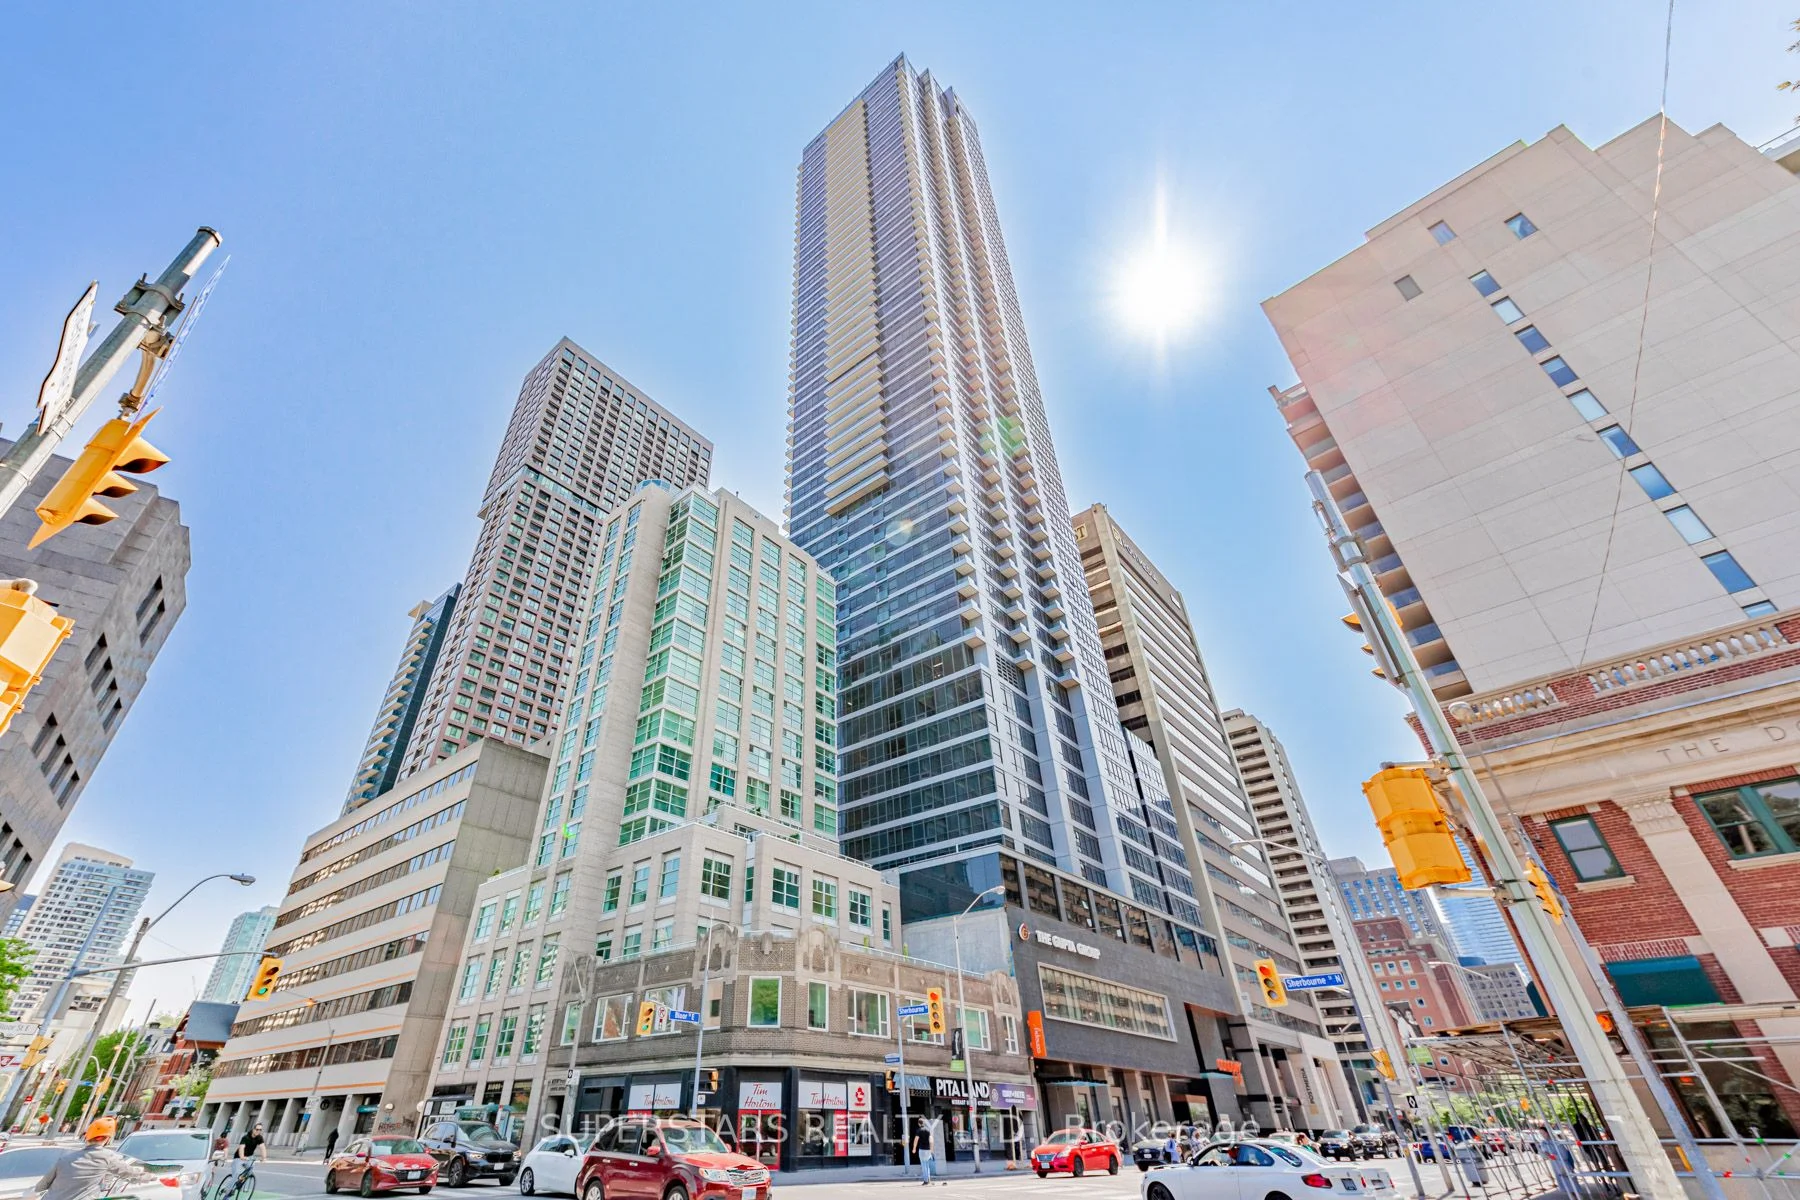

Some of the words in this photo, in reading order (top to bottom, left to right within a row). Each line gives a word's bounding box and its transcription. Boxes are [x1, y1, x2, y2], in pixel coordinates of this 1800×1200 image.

[1656, 737, 1729, 764] THE
[1035, 930, 1053, 946] THE
[1286, 976, 1327, 989] Sherbourne
[1334, 974, 1342, 983] N
[753, 1084, 768, 1096] Tim
[936, 1078, 961, 1097] PITA
[1301, 1067, 1316, 1104] POSTMEDIA
[743, 1096, 777, 1108] Hortons
